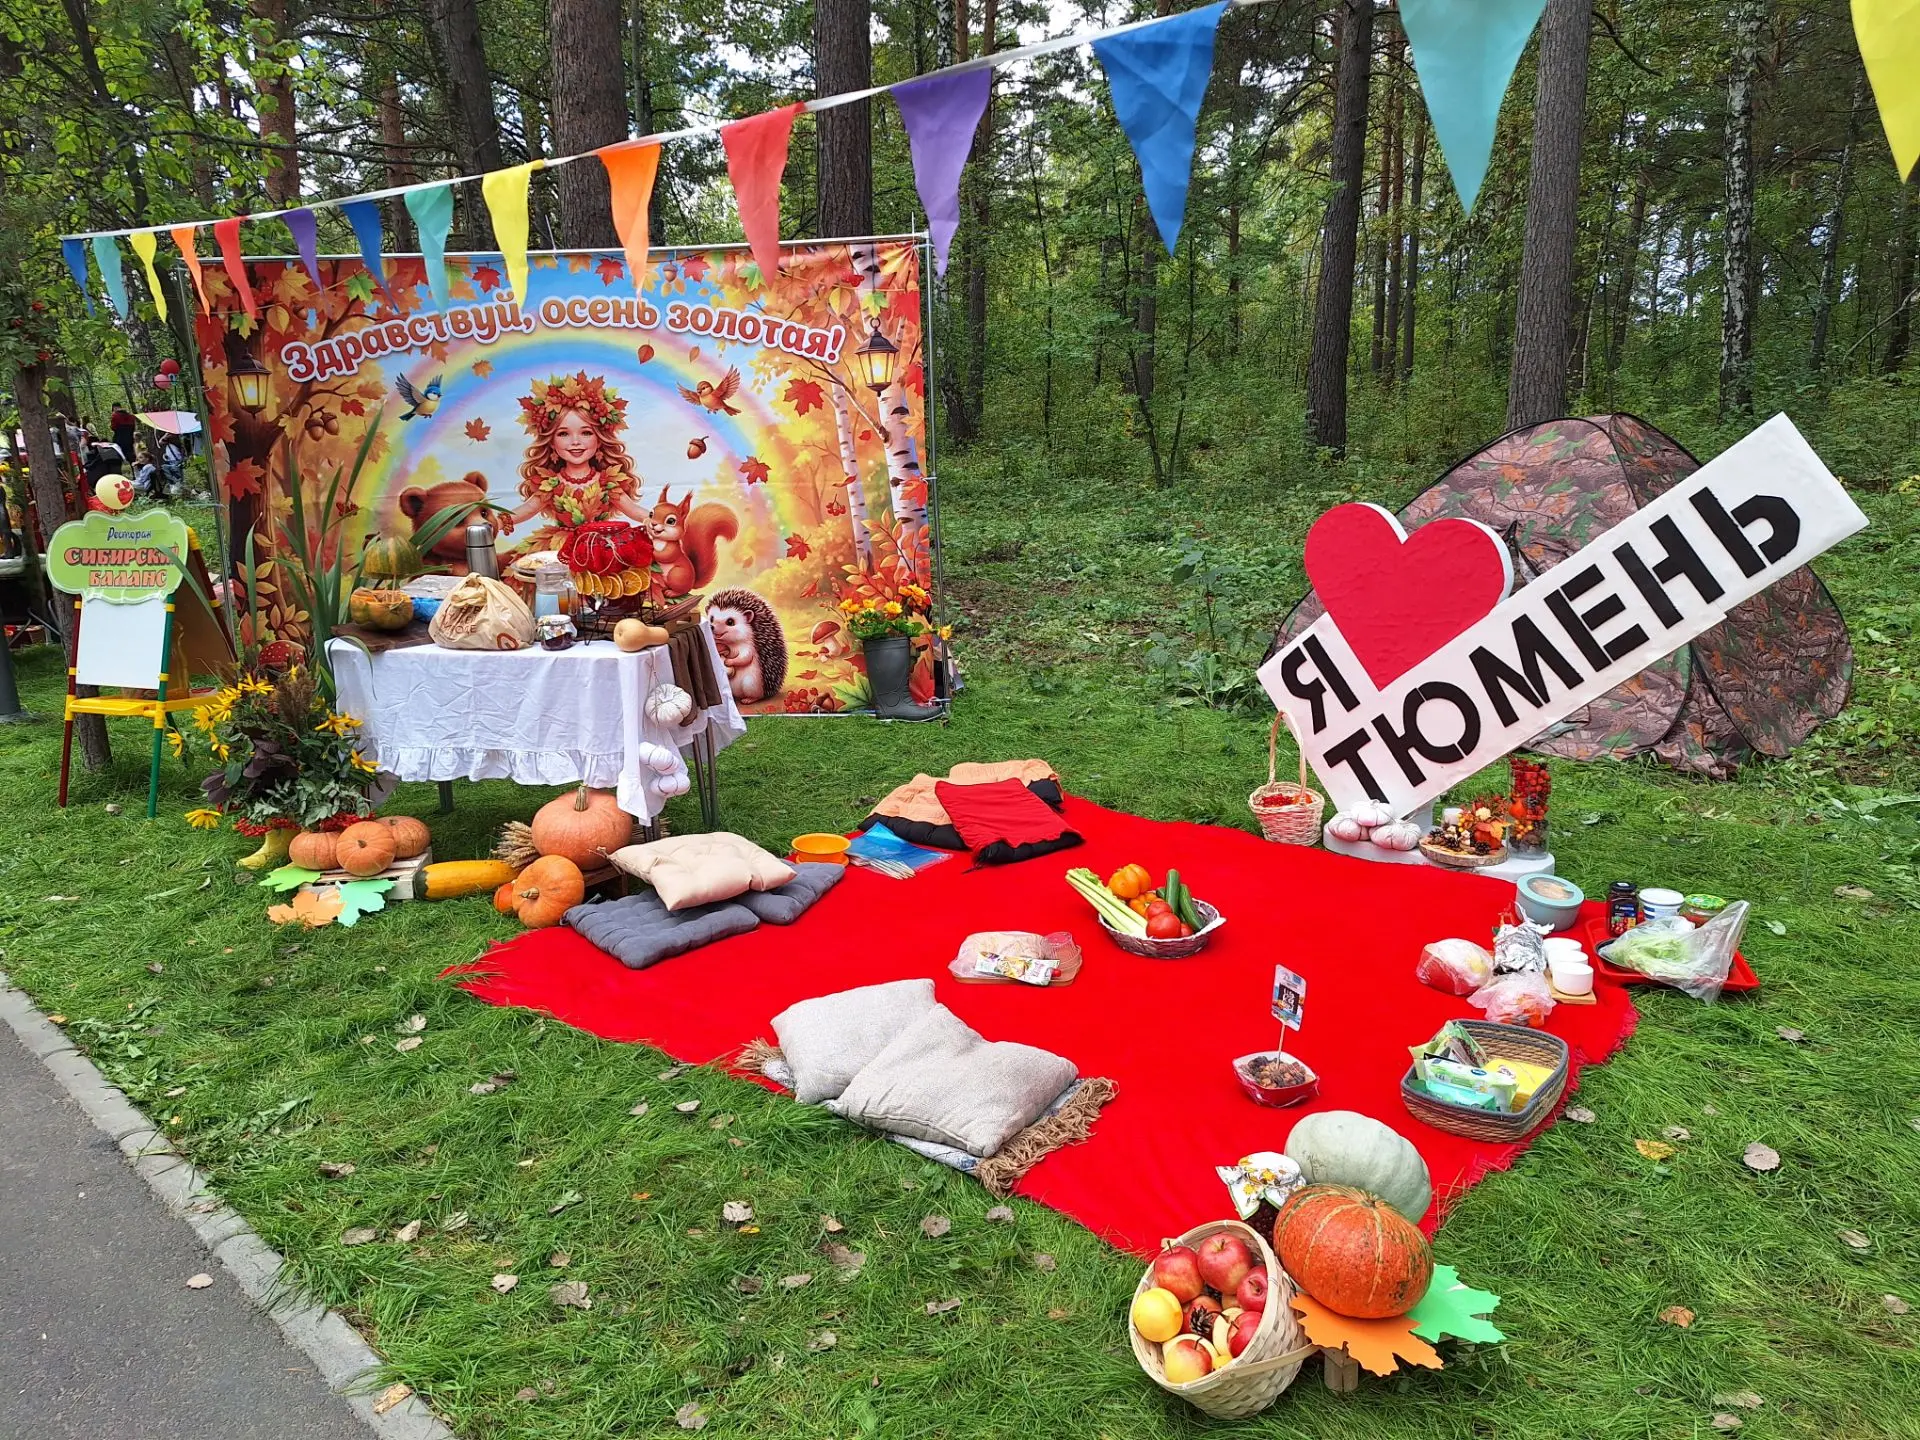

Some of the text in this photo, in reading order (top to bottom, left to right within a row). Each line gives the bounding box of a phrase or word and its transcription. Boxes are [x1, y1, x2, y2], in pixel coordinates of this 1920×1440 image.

[282, 290, 843, 380] Здравствуй, осень золотая!
[89, 569, 168, 588] БАЛАНС
[107, 526, 152, 545] Ресторан
[1281, 634, 1361, 734] Я
[1323, 487, 1801, 804] ТЮМЕНЬ
